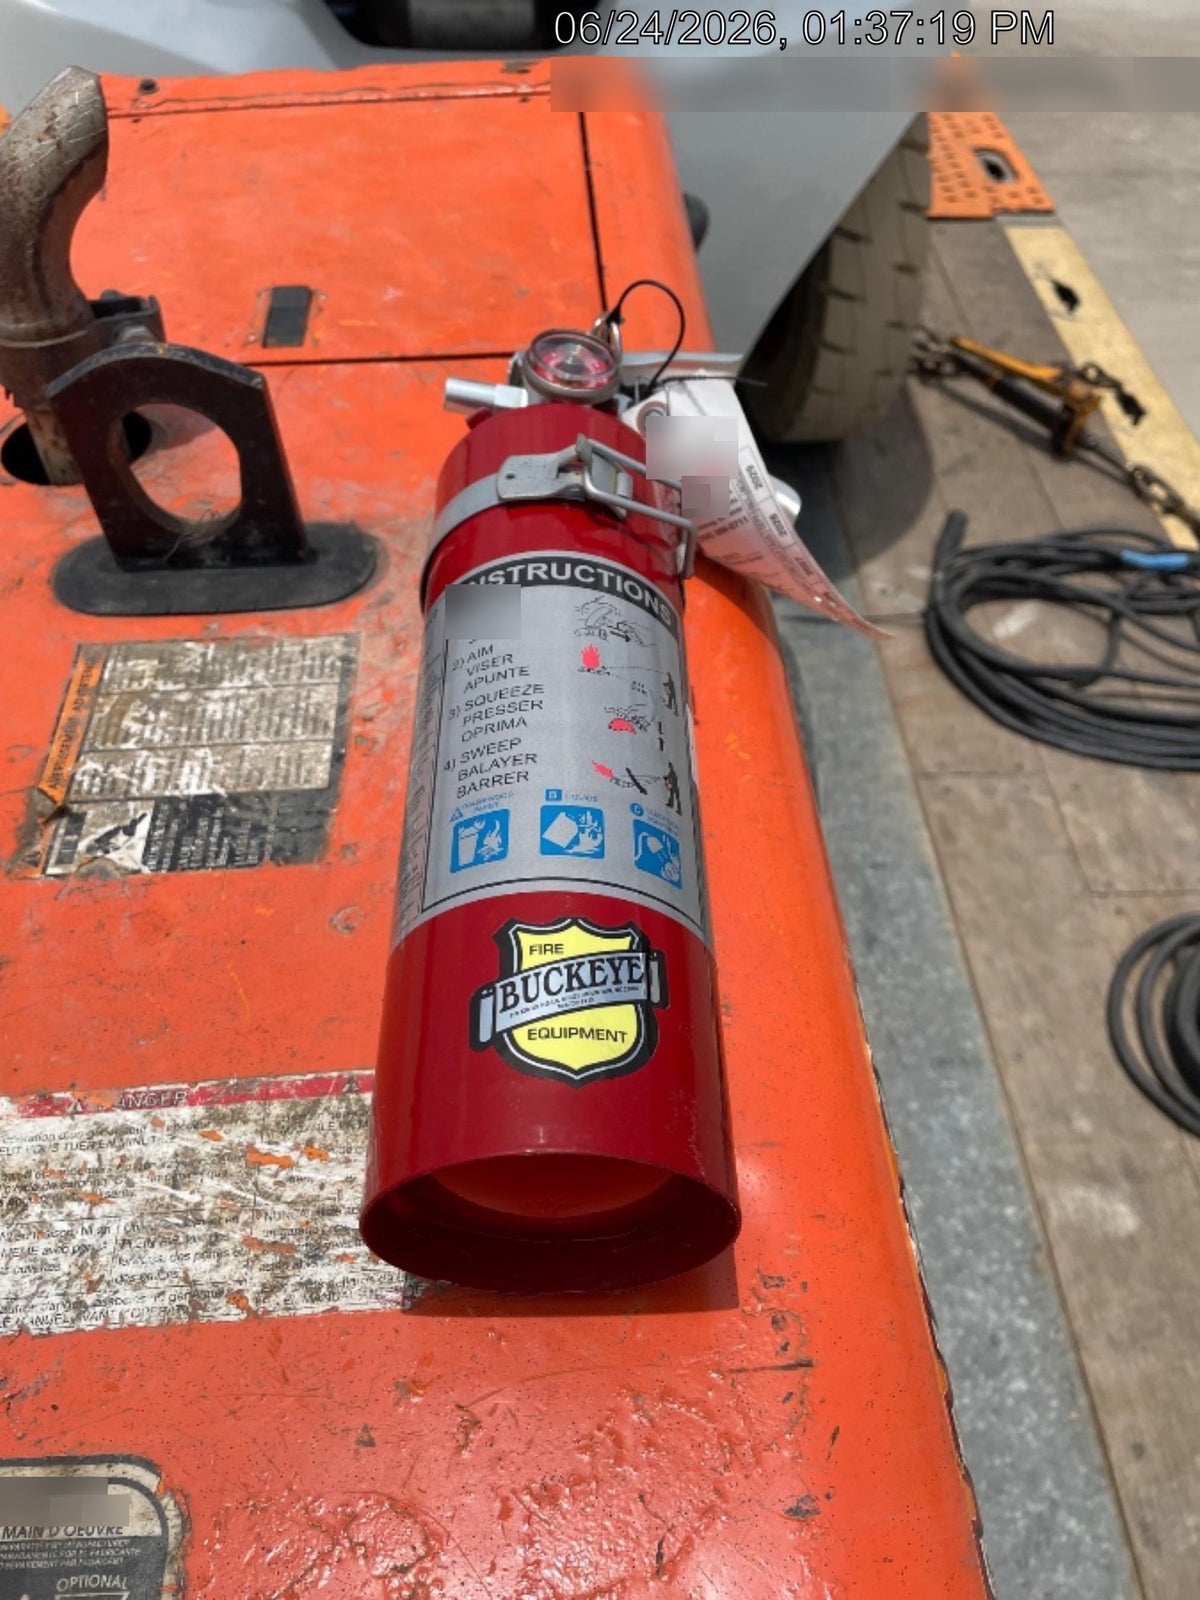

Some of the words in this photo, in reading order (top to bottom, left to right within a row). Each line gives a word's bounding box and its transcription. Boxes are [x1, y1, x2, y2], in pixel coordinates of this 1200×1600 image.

[469, 562, 672, 627] STRUCTIONS
[466, 644, 494, 664] AIM
[467, 654, 514, 676] VISER
[464, 666, 530, 694] APUNTE
[464, 683, 545, 712] SQUEEZE
[462, 699, 544, 728] PRESSER
[460, 716, 528, 743] OPRIMA
[459, 737, 522, 765] SWEEP
[457, 753, 538, 782] BALAYER
[456, 770, 530, 799] BARRER
[529, 943, 565, 956] FIRE
[499, 955, 646, 1014] BUCKEYE
[527, 1026, 628, 1044] EQUIPMENT
[2, 1526, 45, 1539] MAIN
[56, 1574, 127, 1592] OPTIONAL
